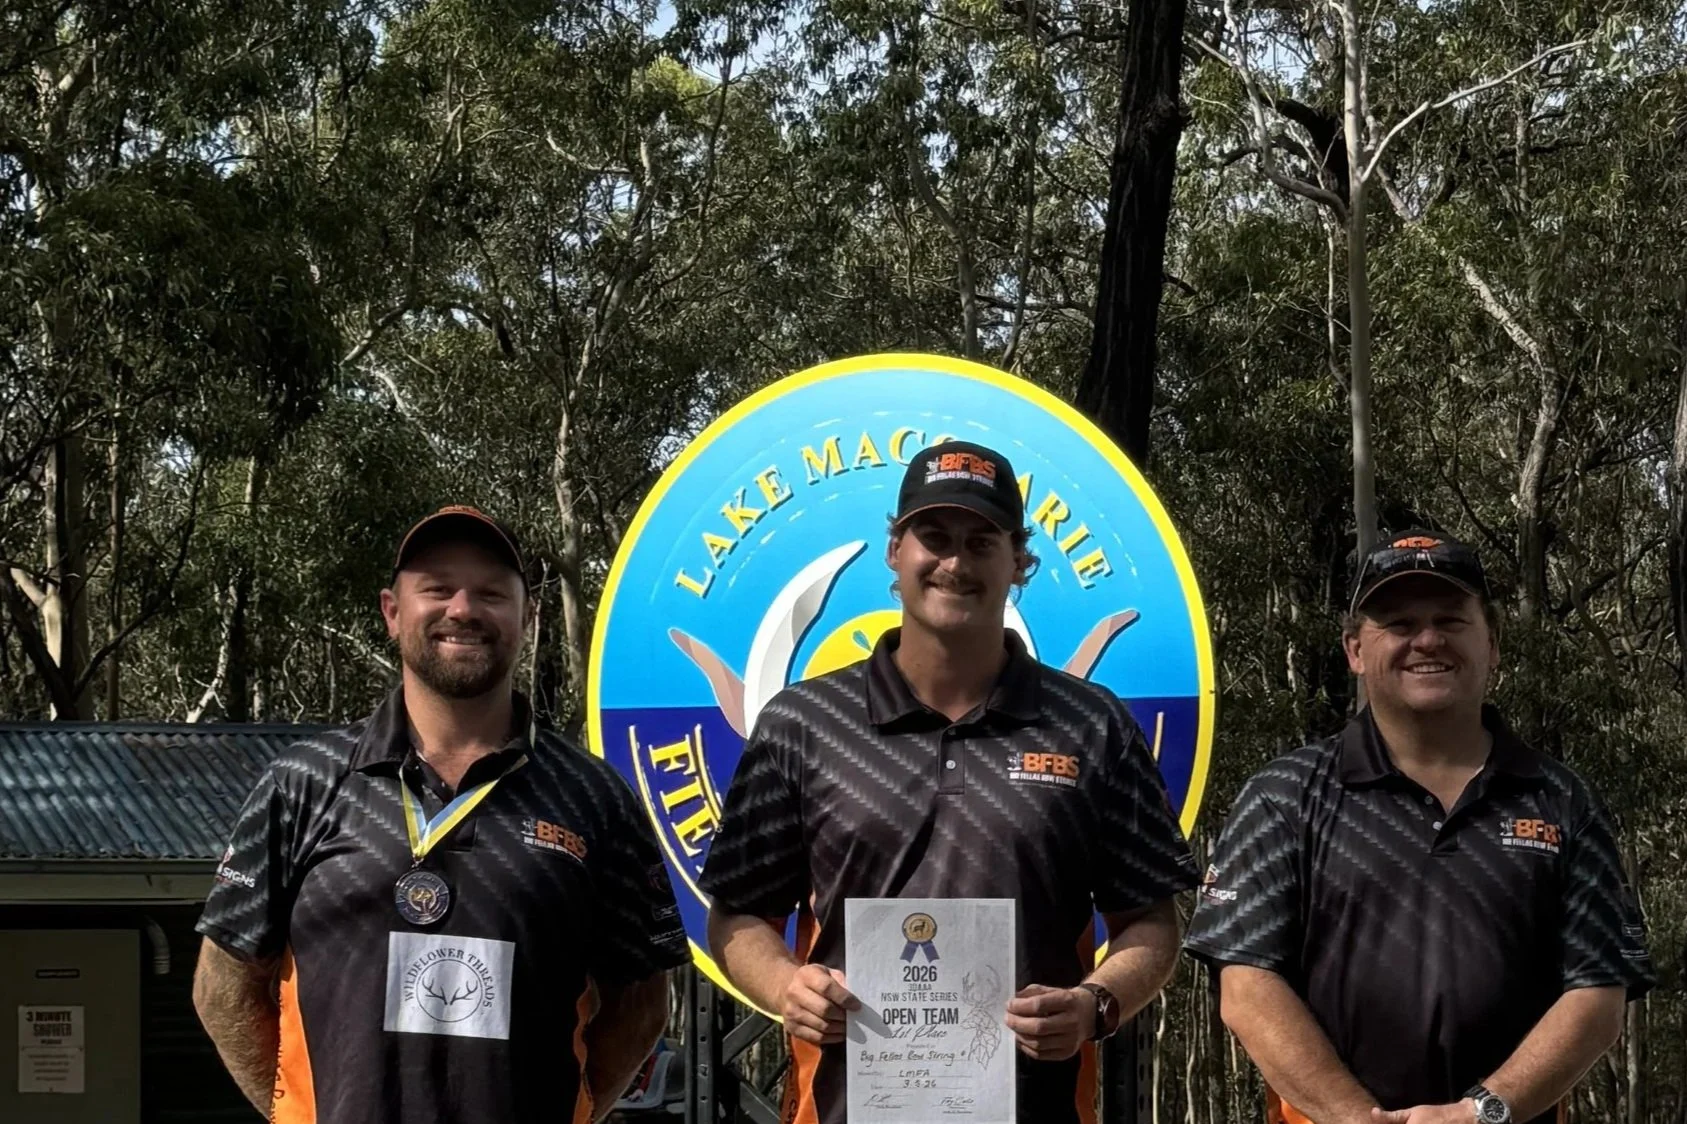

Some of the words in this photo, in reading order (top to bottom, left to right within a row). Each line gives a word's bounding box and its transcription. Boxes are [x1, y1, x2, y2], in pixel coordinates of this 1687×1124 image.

[940, 453, 996, 480] BFBS
[674, 464, 794, 600] LAKE
[800, 427, 1114, 590] MACARIE
[1024, 752, 1080, 779] BFBS
[648, 734, 718, 873] FIE
[536, 820, 588, 858] BFBS
[221, 867, 256, 888] SIGNS
[404, 948, 465, 1002] WILDFLOWER
[468, 954, 495, 1008] THREADS
[903, 966, 938, 982] 2026
[881, 992, 900, 1001] NSW
[902, 992, 928, 1001] STATE
[930, 992, 958, 1001] SERIES
[26, 1011, 34, 1022] 3
[35, 1011, 72, 1022] MINUTE
[882, 1008, 917, 1025] OPEN
[923, 1008, 959, 1025] TEAM
[33, 1023, 72, 1037] SHOWER
